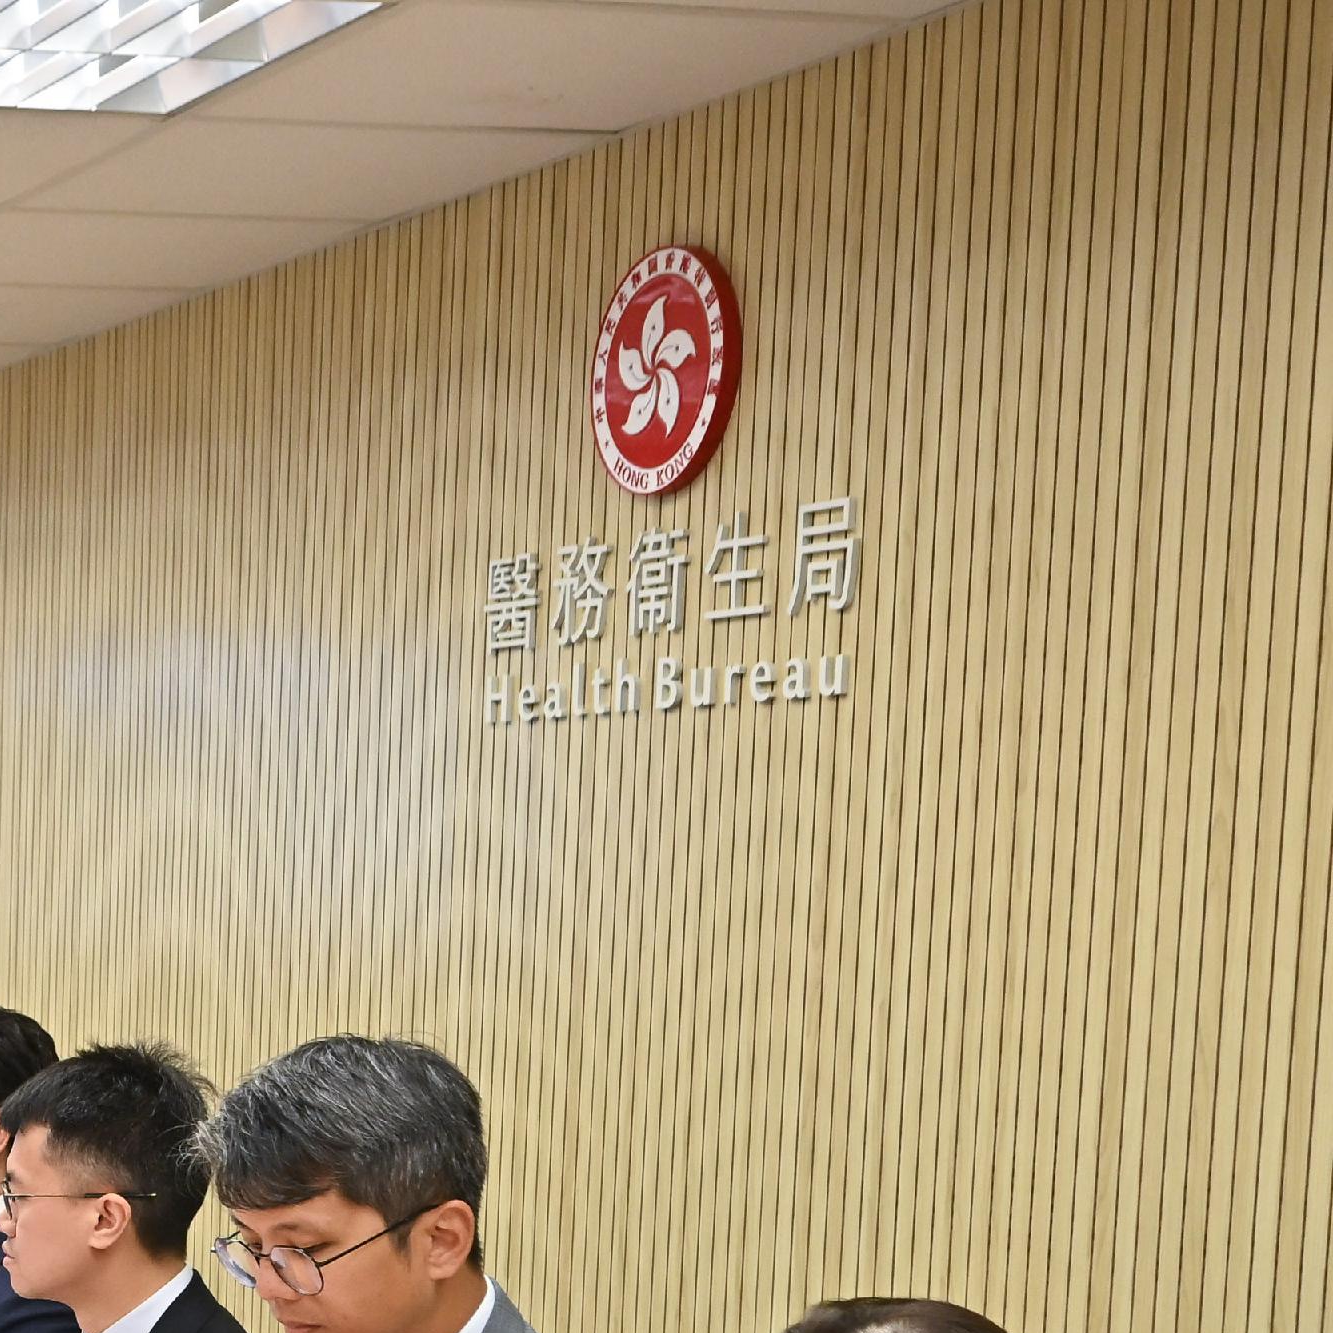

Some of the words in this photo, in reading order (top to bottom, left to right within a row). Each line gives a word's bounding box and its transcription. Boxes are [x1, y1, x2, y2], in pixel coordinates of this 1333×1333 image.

[613, 456, 650, 490] HONG
[655, 441, 695, 488] KONG
[484, 655, 641, 724] Health
[654, 652, 849, 711] Bureau
